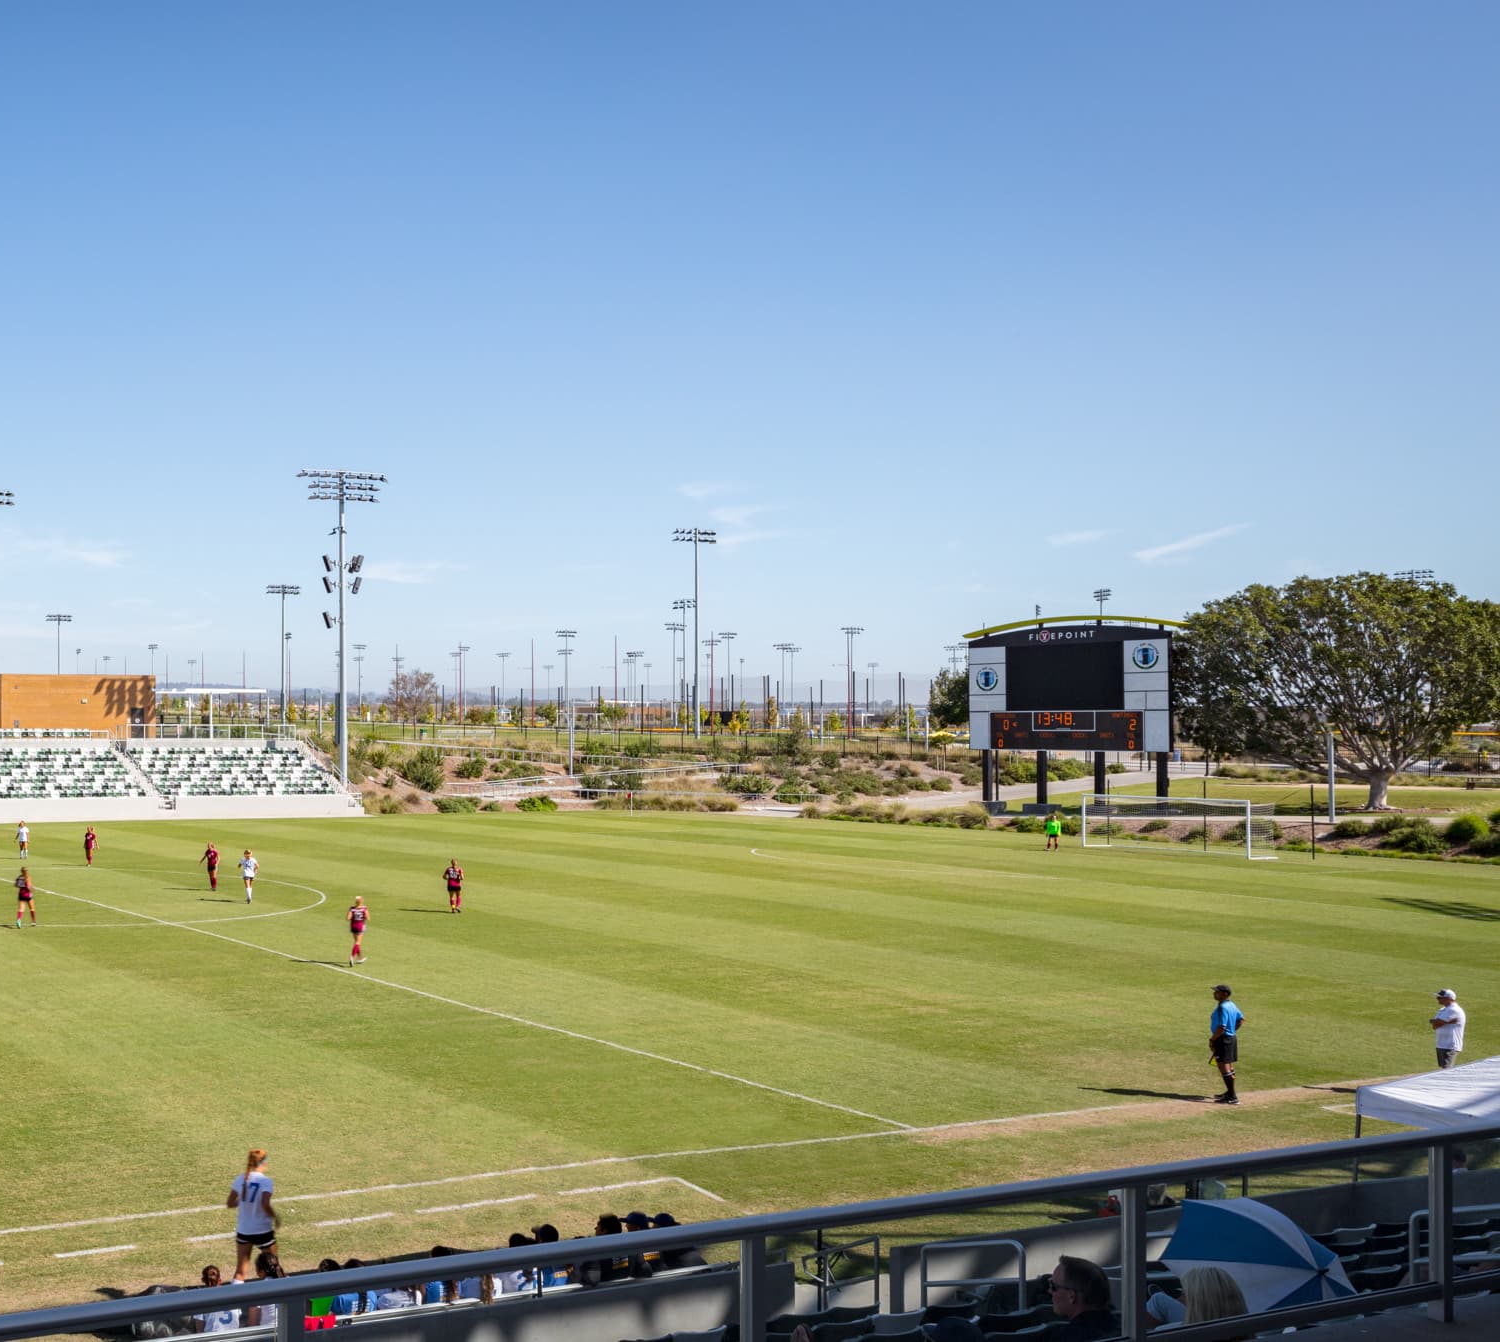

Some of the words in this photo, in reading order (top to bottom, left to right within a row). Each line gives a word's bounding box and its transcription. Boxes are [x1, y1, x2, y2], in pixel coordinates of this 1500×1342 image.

[1028, 630, 1094, 642] FIVEPOINT
[1003, 719, 1009, 731] 0
[1037, 712, 1072, 726] 13:48
[1129, 719, 1137, 731] 2
[997, 739, 1003, 748] 0
[1127, 740, 1134, 749] 0
